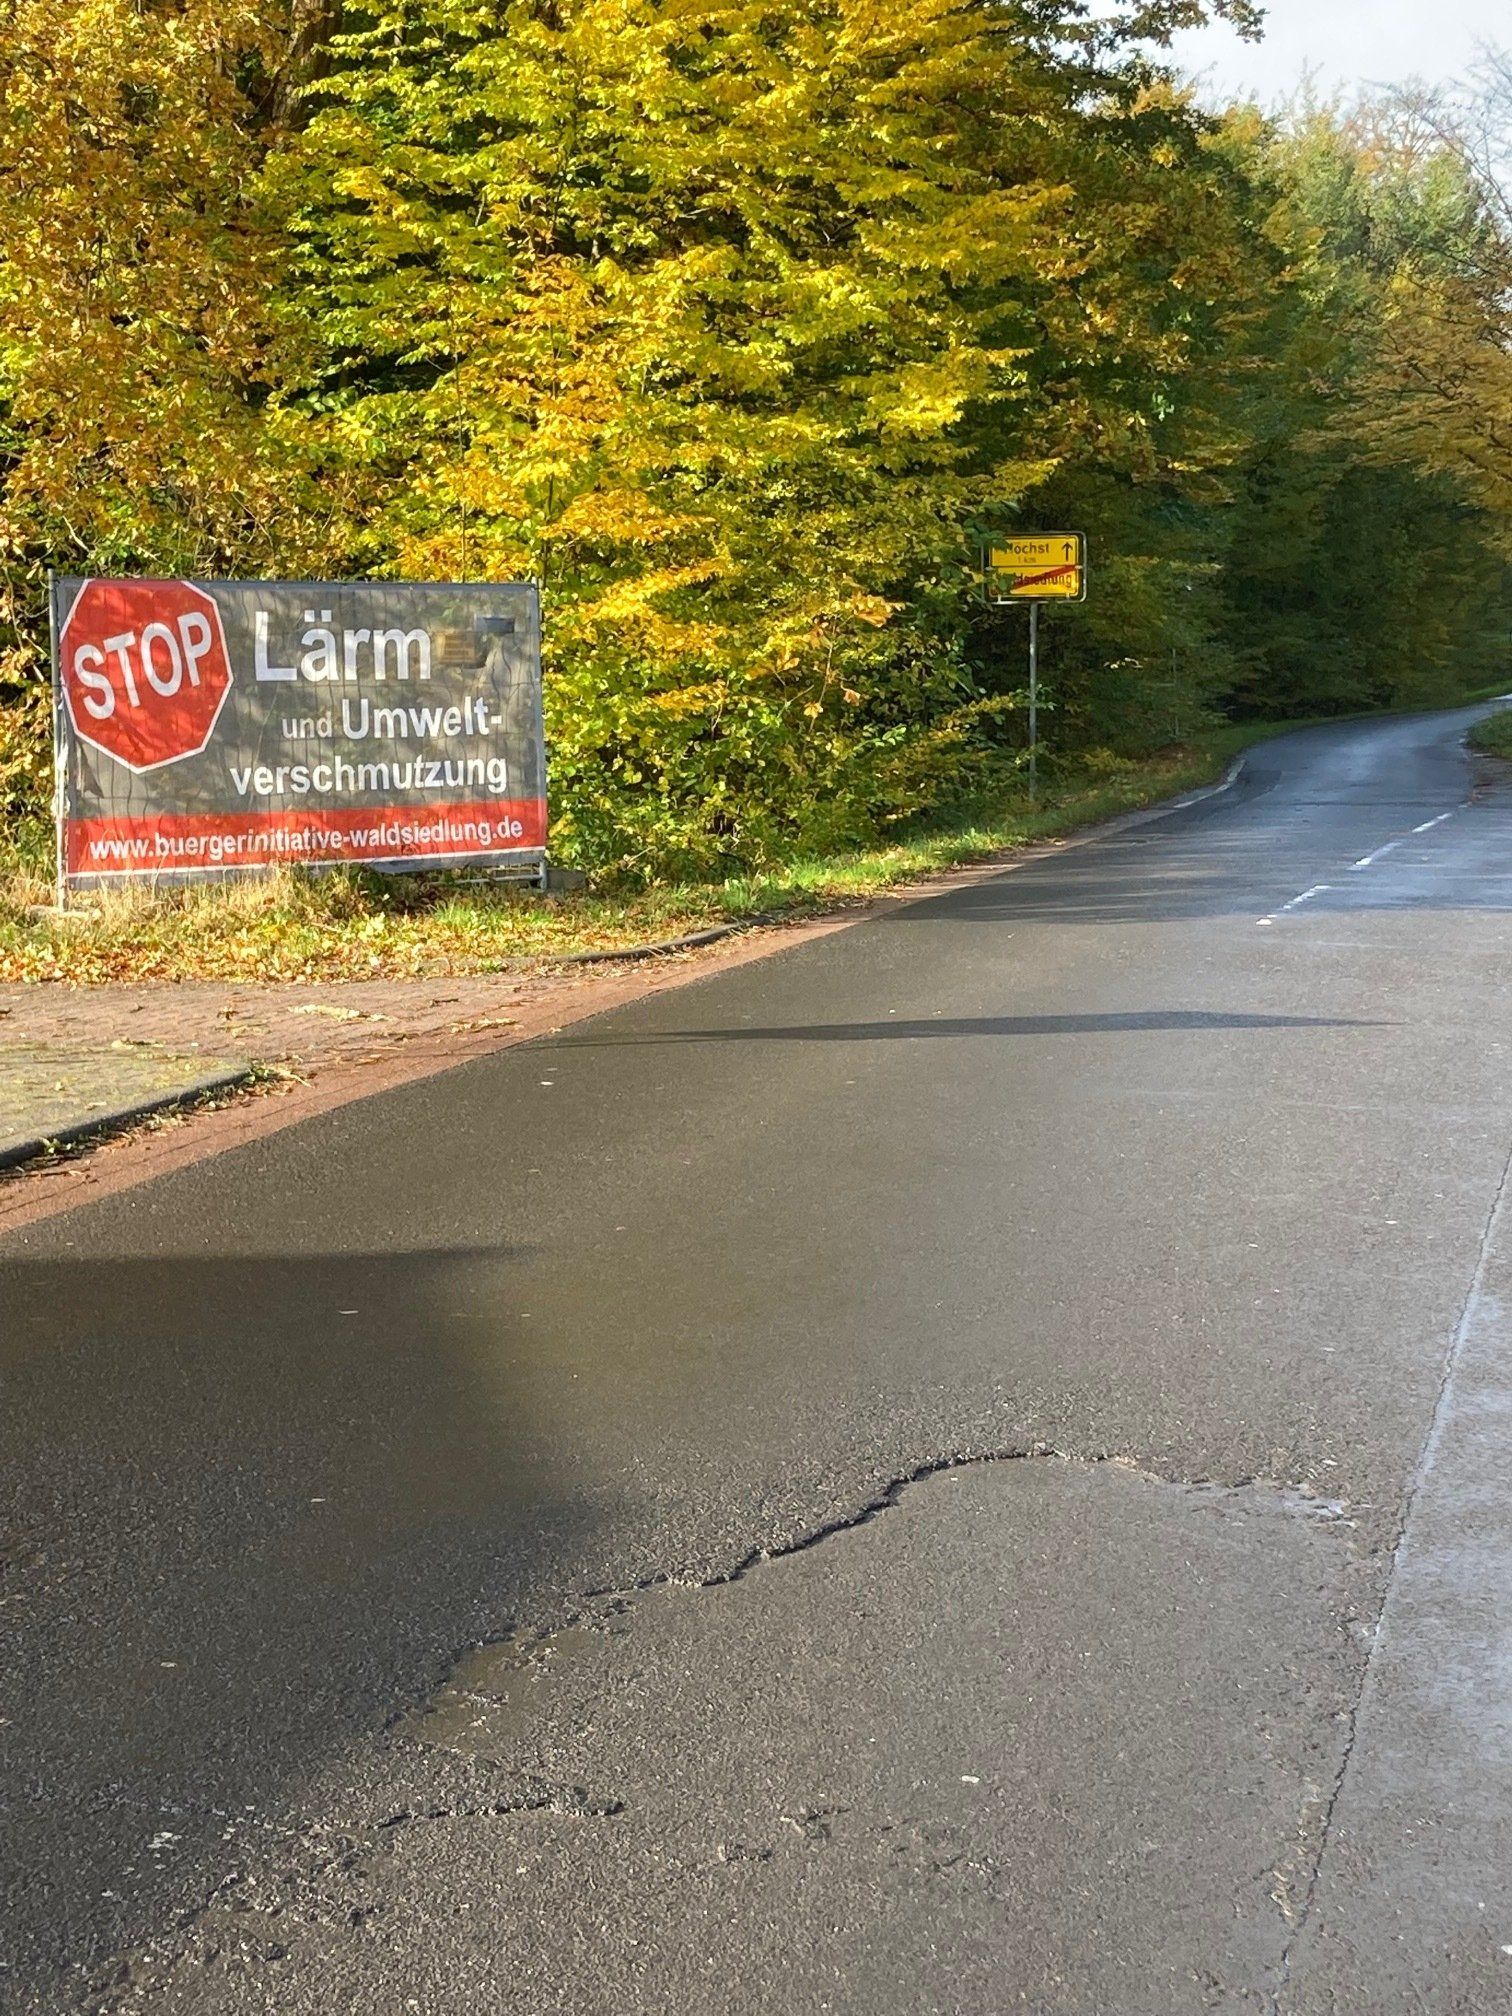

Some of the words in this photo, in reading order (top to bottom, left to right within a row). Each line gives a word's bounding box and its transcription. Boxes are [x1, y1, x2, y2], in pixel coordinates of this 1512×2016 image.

[74, 611, 213, 720] STOP
[255, 609, 432, 682] Lärm
[282, 713, 333, 739] und
[342, 696, 502, 740] Umwelt-
[230, 755, 507, 795] verschmutzung
[90, 816, 524, 861] www.buergerinitiative-waldsiedlung.de
